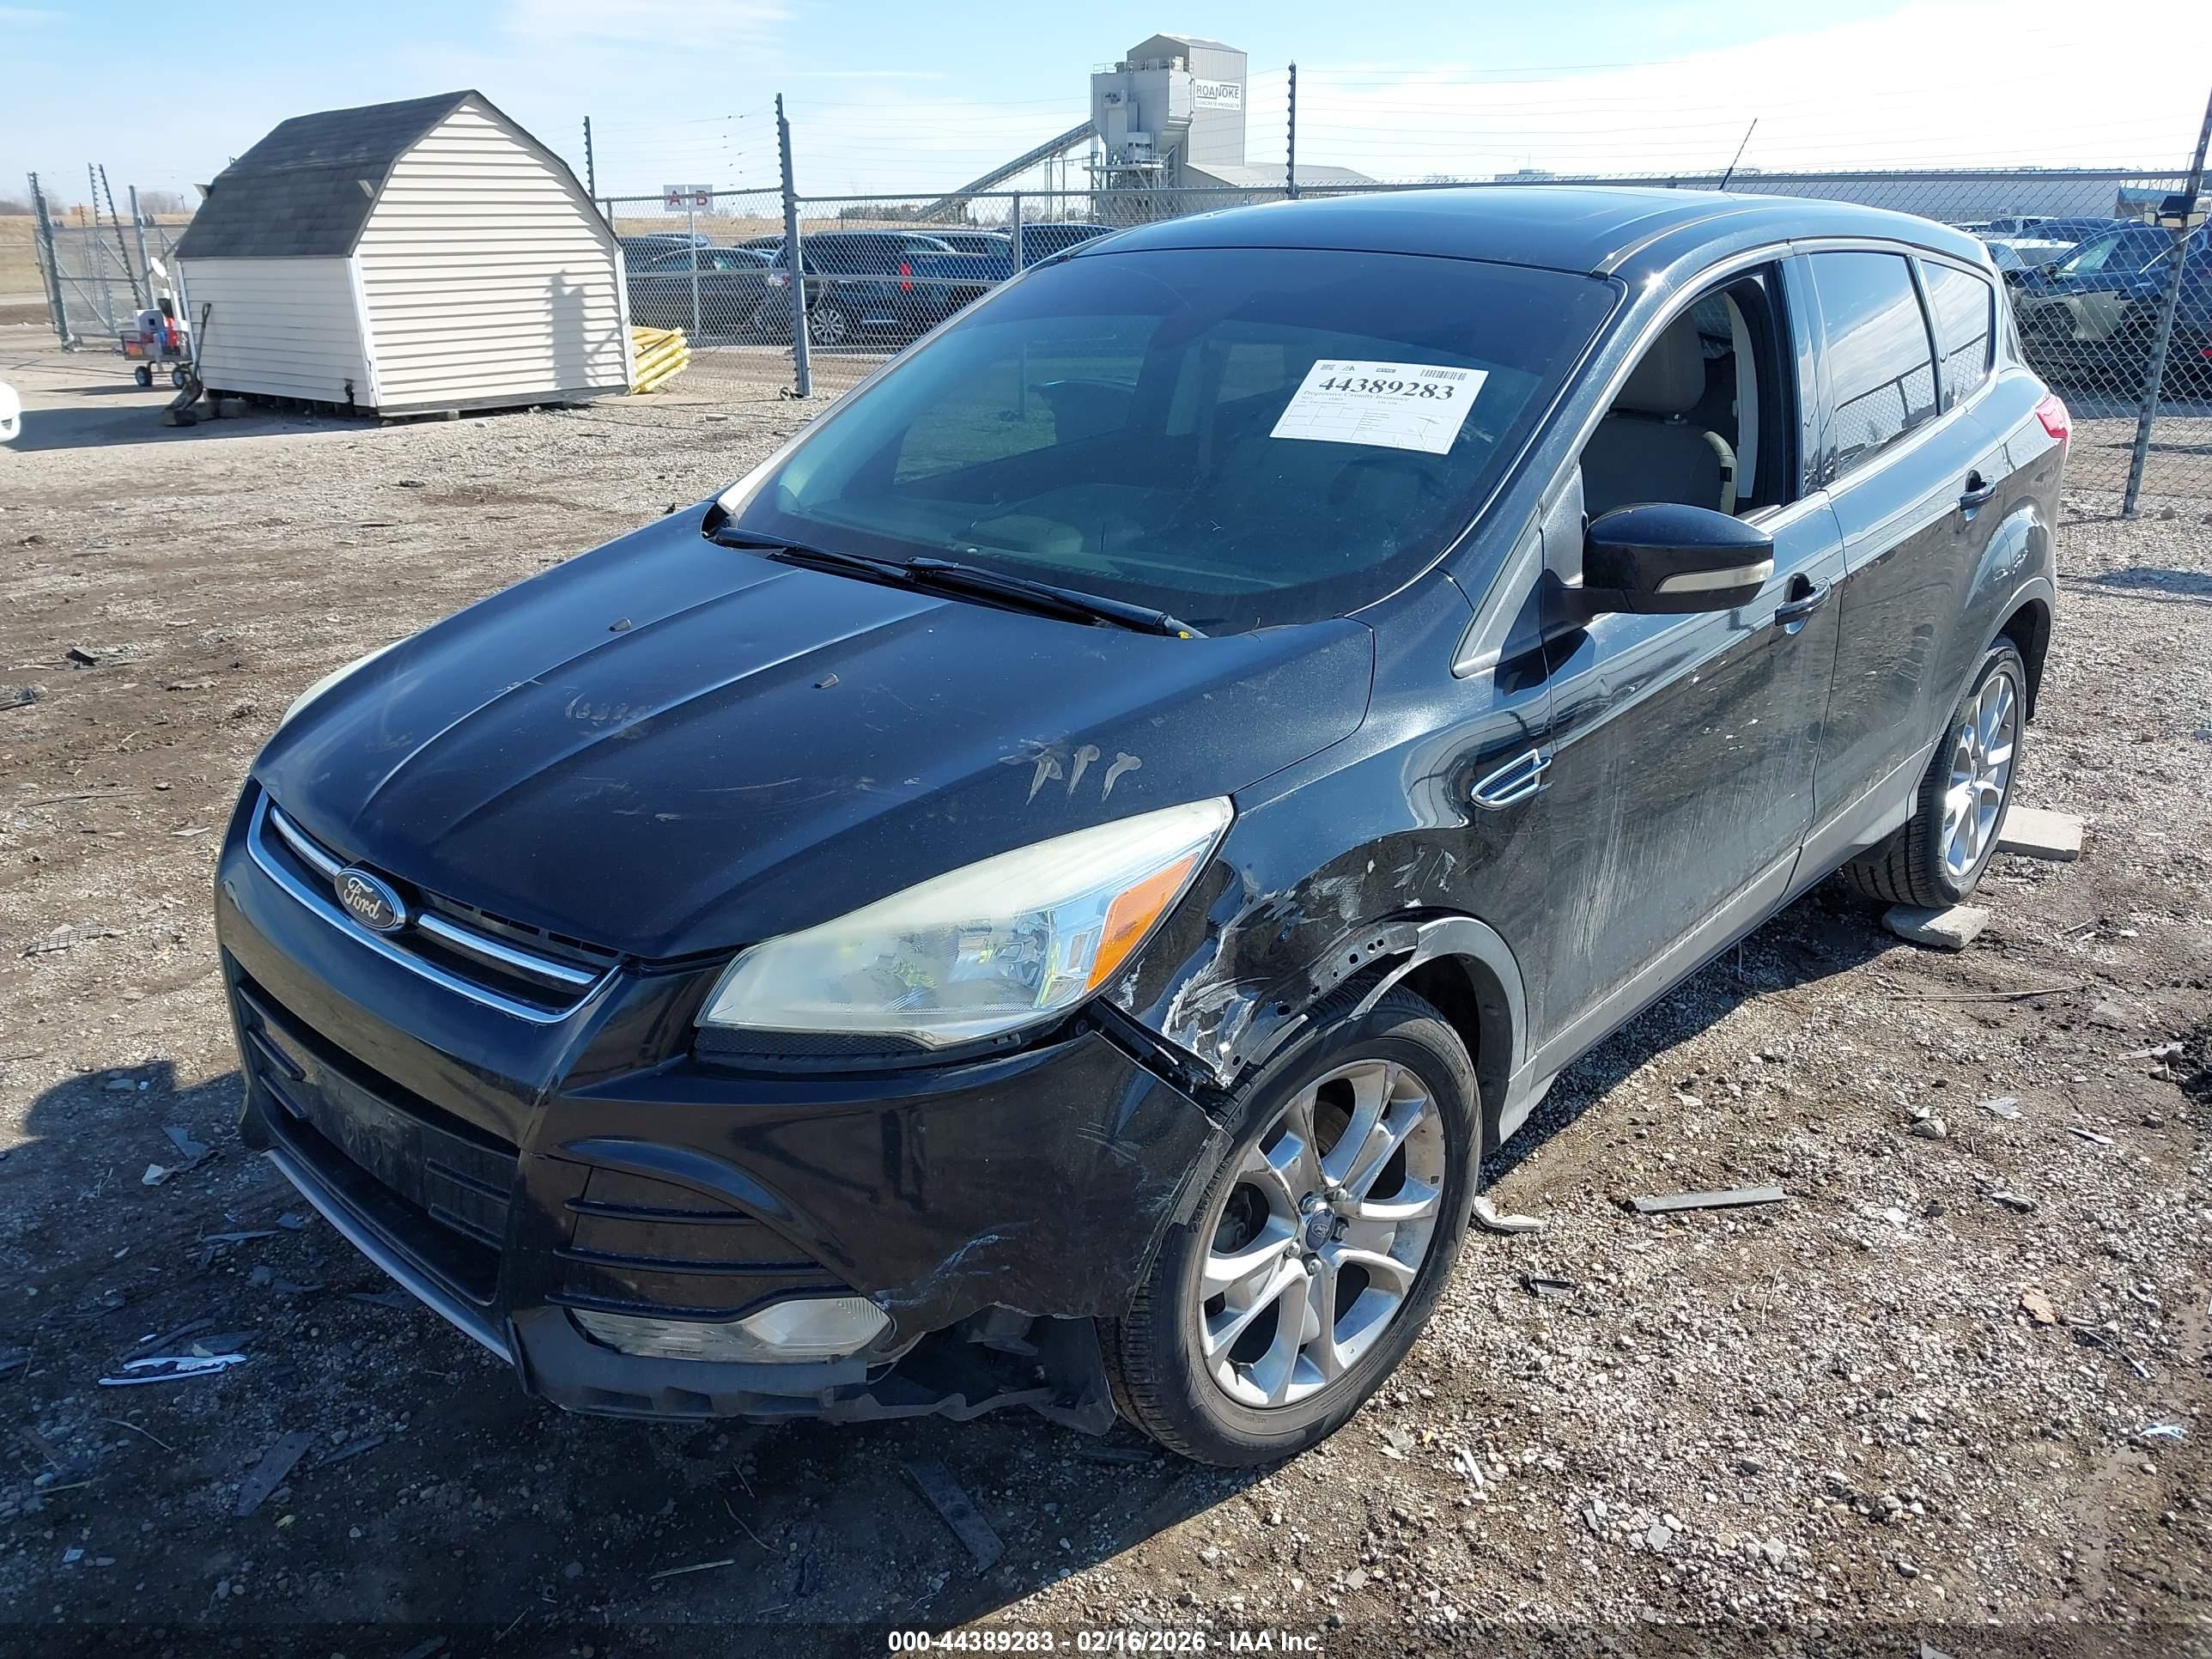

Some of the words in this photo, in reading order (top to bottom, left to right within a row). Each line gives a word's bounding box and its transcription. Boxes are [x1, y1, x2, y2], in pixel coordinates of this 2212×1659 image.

[1196, 84, 1240, 100] ROANOKE
[669, 190, 681, 206] A
[696, 190, 708, 205] B
[1318, 377, 1455, 400] 44389283
[343, 877, 381, 920] Ford
